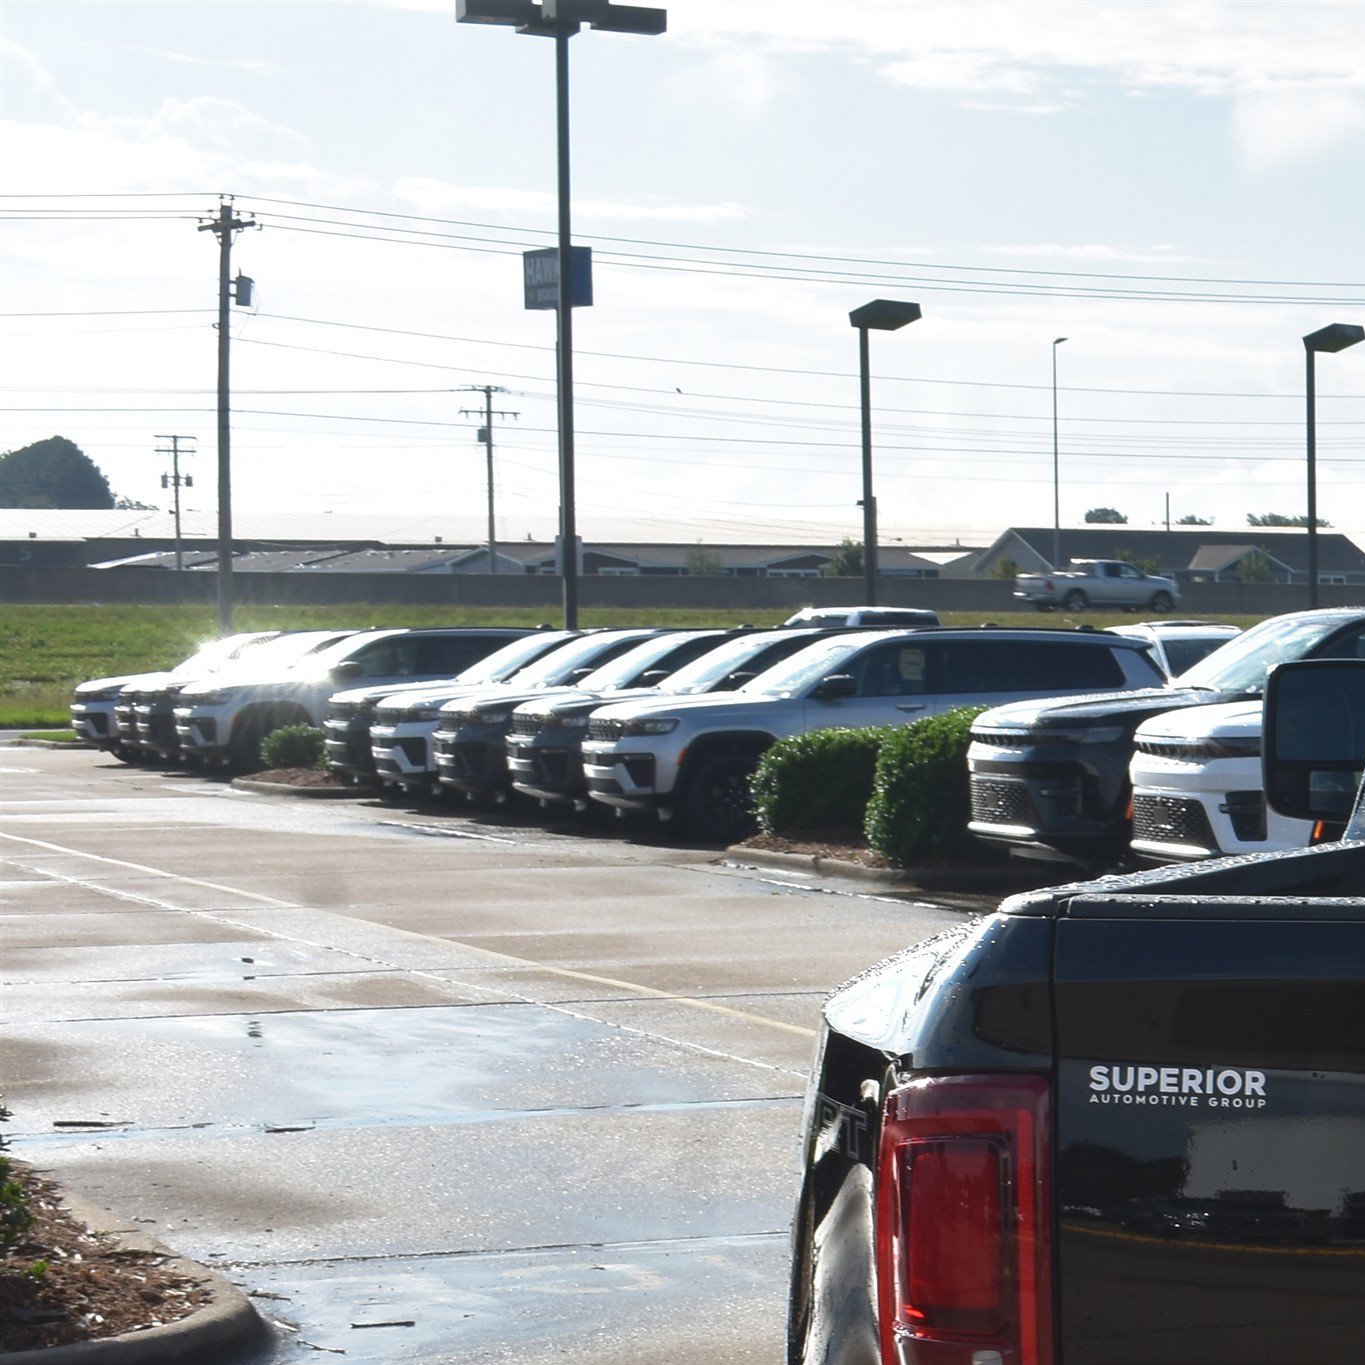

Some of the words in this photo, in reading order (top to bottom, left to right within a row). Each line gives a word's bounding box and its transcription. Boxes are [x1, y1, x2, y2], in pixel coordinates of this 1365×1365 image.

[1089, 1065, 1267, 1096] SUPERIOR
[1089, 1093, 1199, 1107] AUTOMOTIVE
[1208, 1097, 1267, 1109] GROUP
